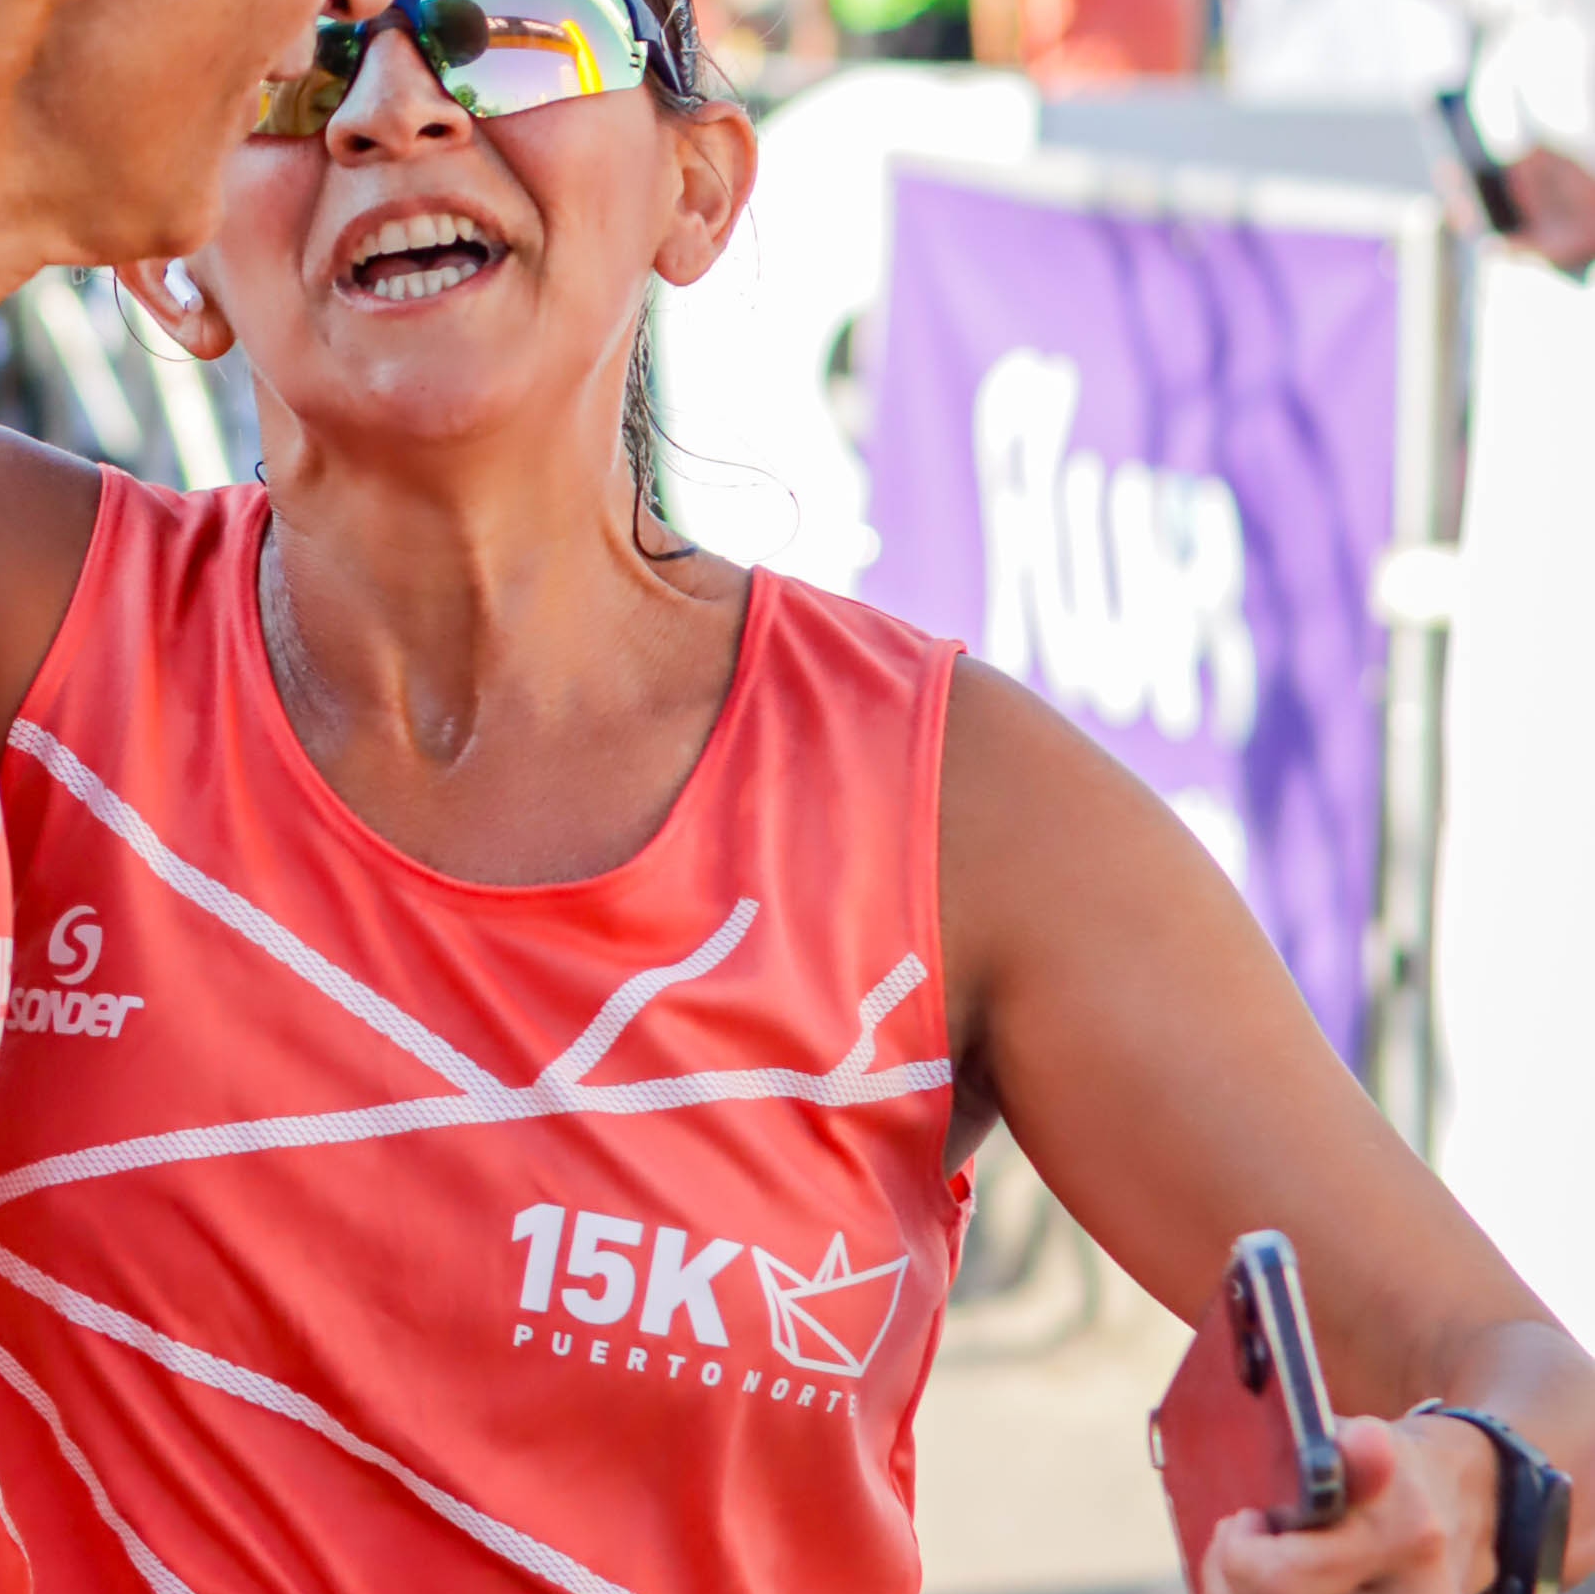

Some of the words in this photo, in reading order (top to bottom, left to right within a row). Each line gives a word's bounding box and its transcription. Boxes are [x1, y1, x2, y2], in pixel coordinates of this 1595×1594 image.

[511, 1202, 744, 1347] 15K
[513, 1324, 722, 1386] PUERTO
[742, 1369, 856, 1417] NORTE
